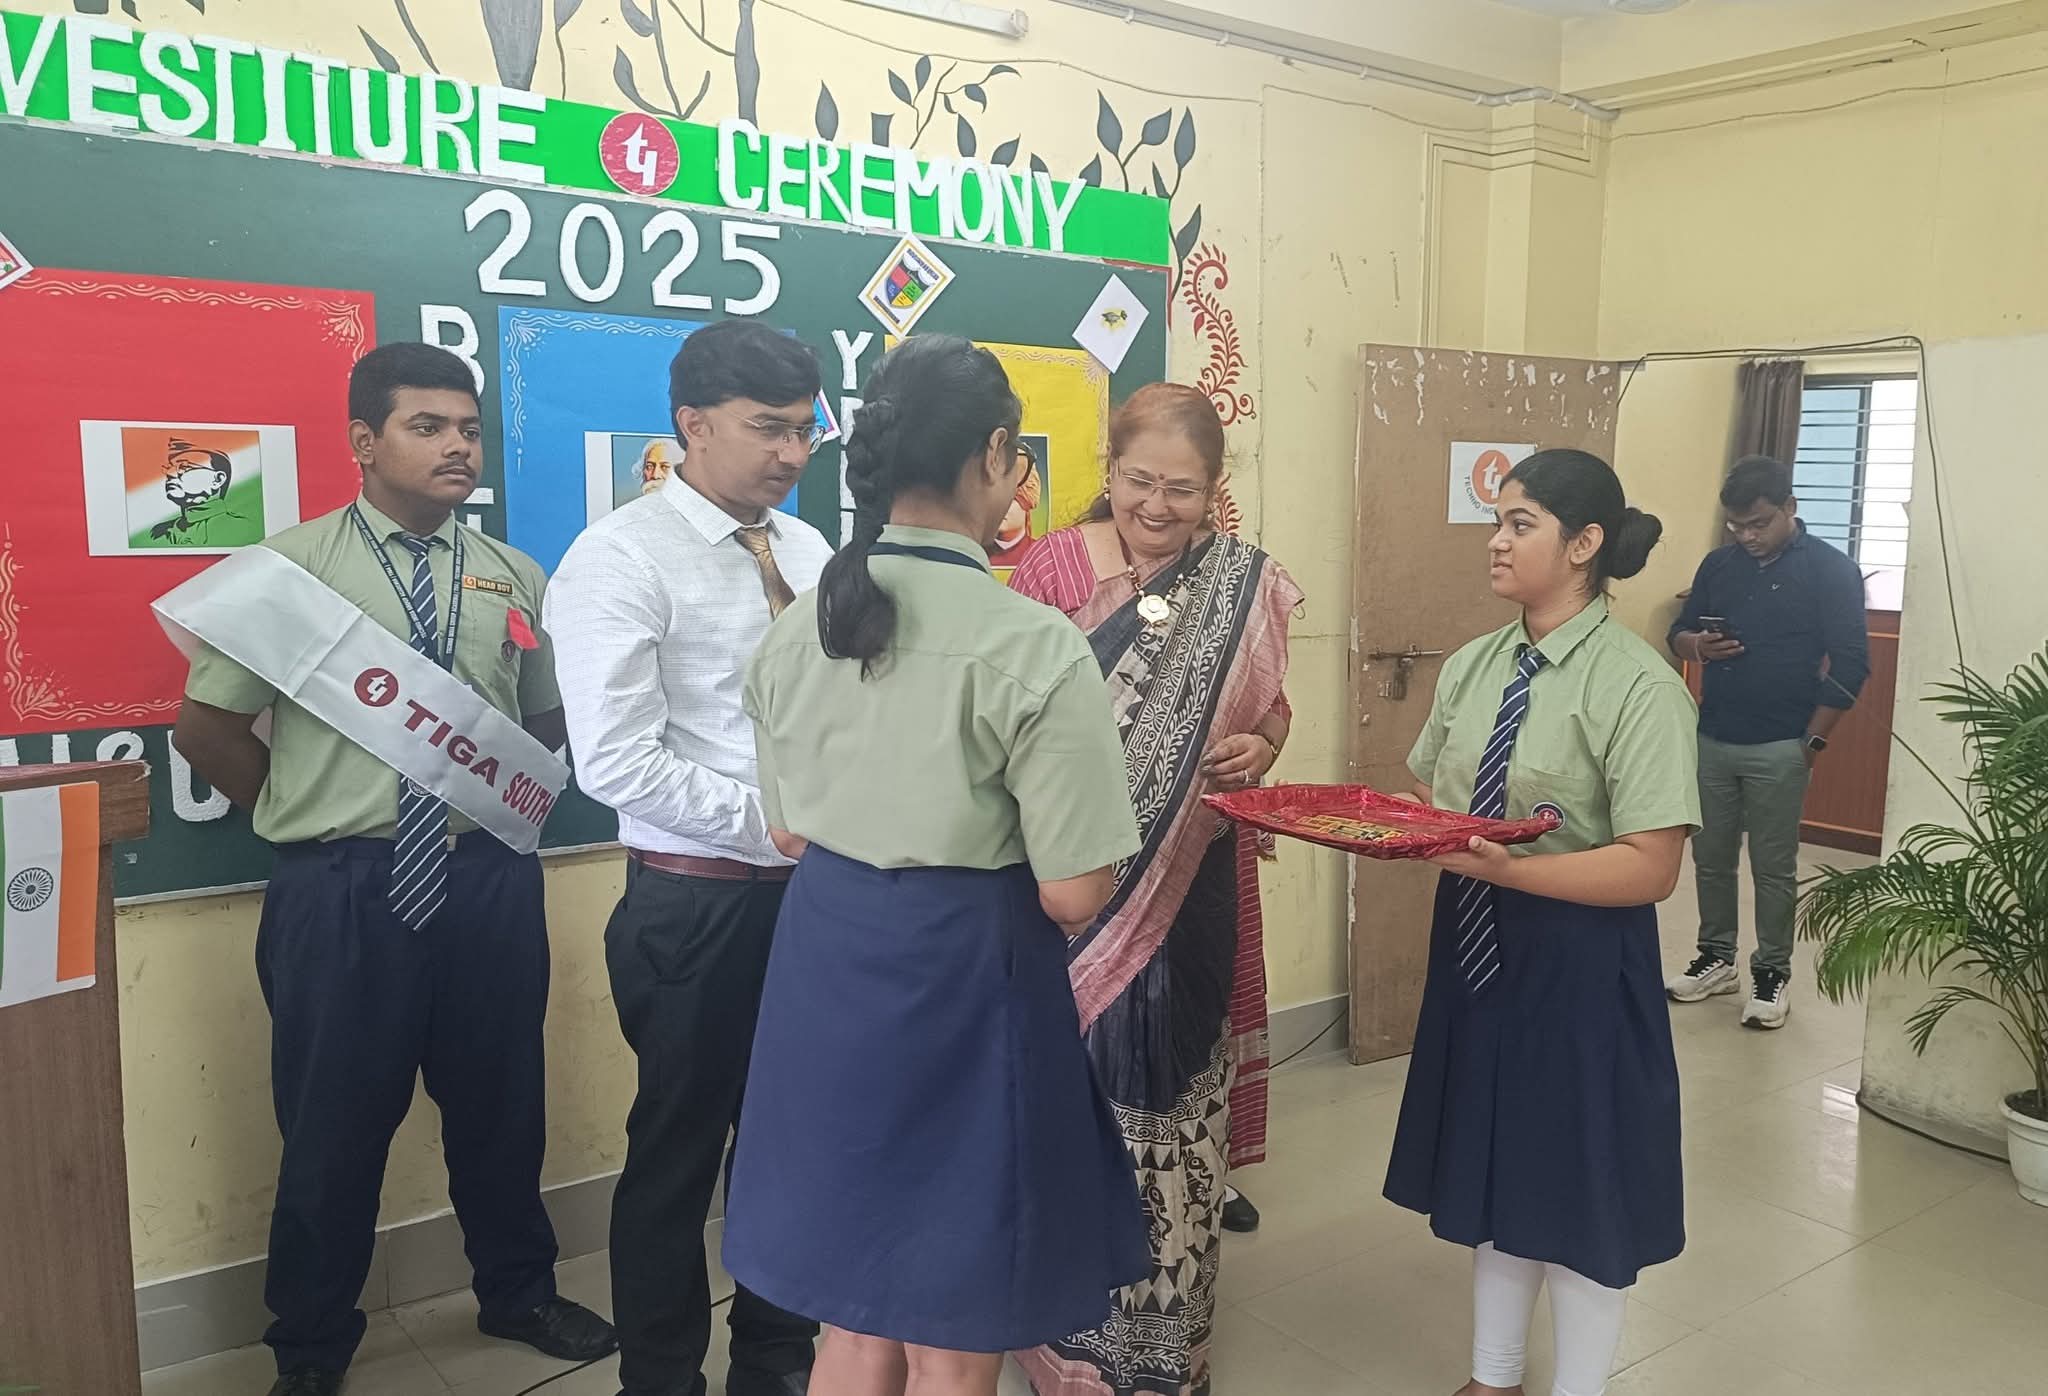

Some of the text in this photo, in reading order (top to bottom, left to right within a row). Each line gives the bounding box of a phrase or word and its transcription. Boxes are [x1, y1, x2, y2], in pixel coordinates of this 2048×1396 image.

[717, 118, 1087, 253] CEREMONY
[463, 189, 781, 316] 2025
[477, 579, 511, 593] HEAD BOY
[404, 699, 556, 827] TIGA SOUTH
